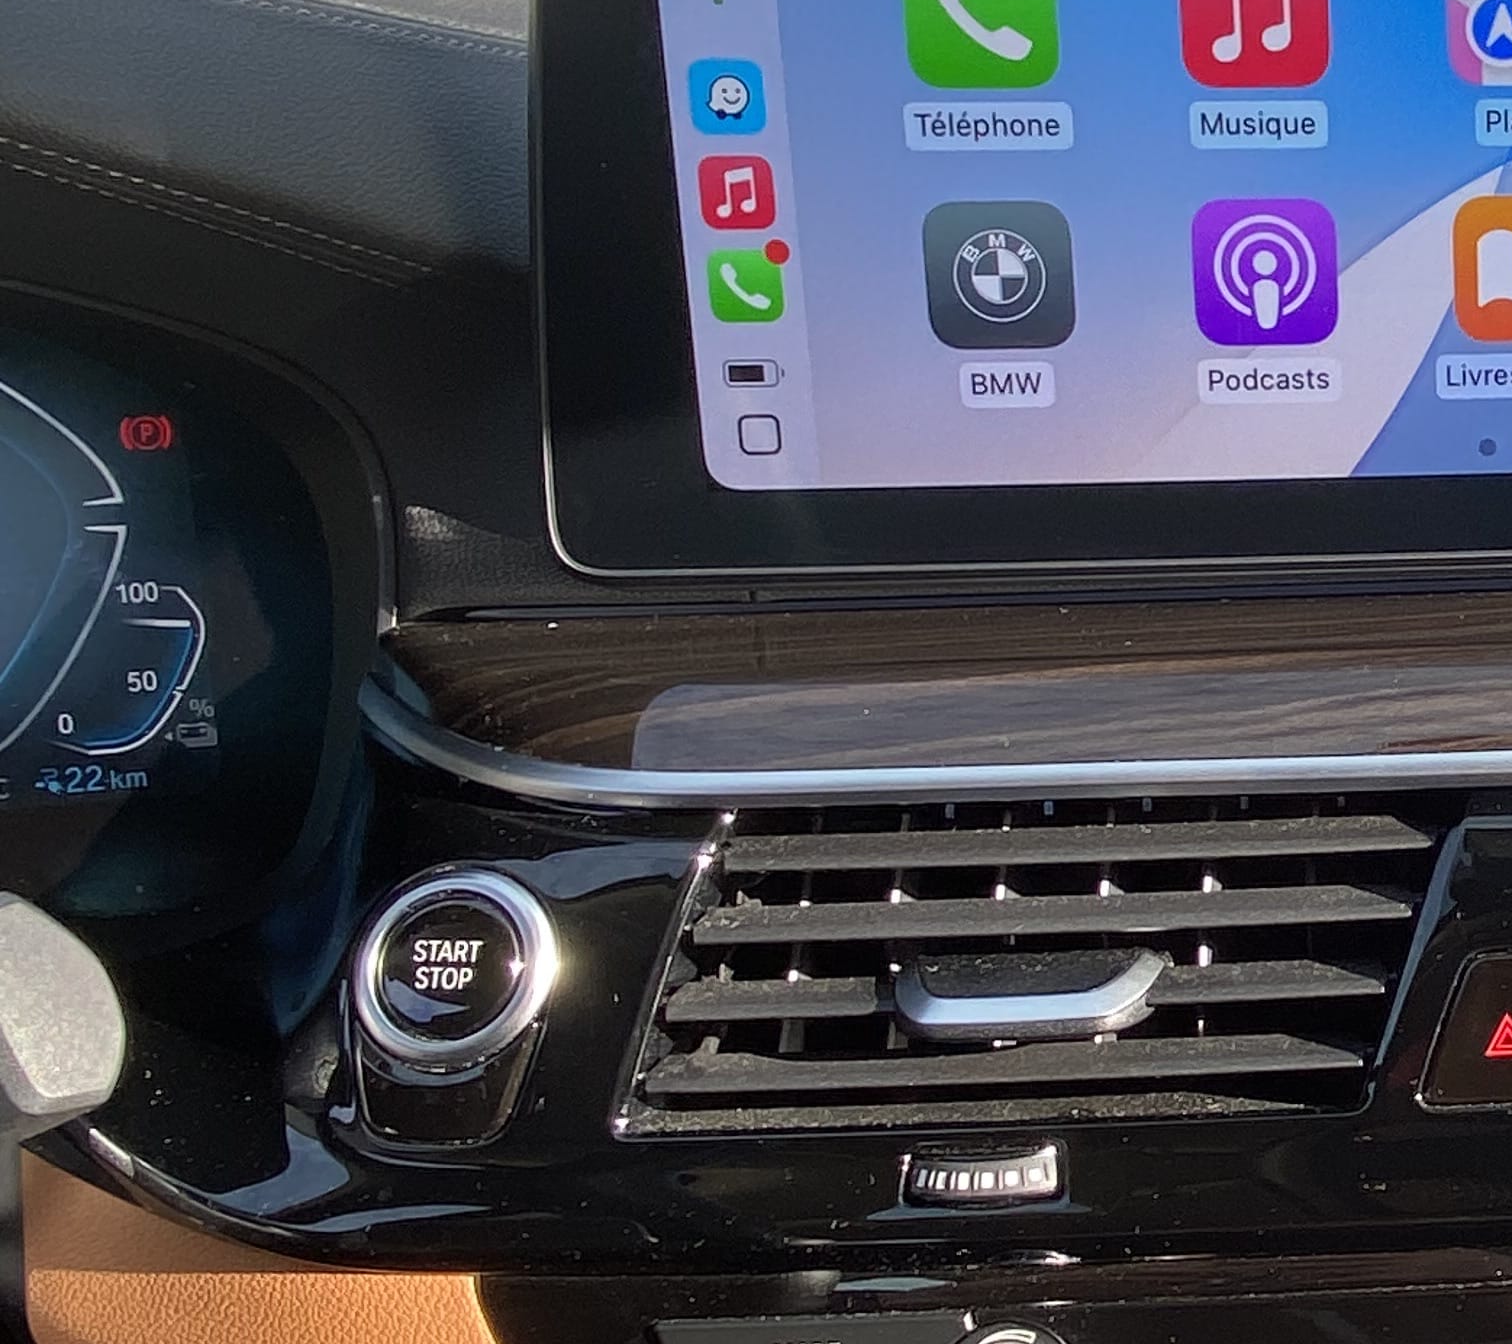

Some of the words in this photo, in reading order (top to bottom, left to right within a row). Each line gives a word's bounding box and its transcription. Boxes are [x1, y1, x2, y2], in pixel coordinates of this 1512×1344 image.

[913, 109, 1061, 142] Téléphone
[1200, 111, 1316, 141] Musique
[961, 233, 1035, 263] BMW
[970, 373, 1042, 396] BMW
[1208, 367, 1331, 392] Podcasts
[115, 581, 158, 603] 100
[127, 670, 158, 693] 50
[57, 713, 74, 734] 0
[110, 770, 148, 789] km
[412, 939, 483, 962] START
[414, 966, 474, 990] STOP
